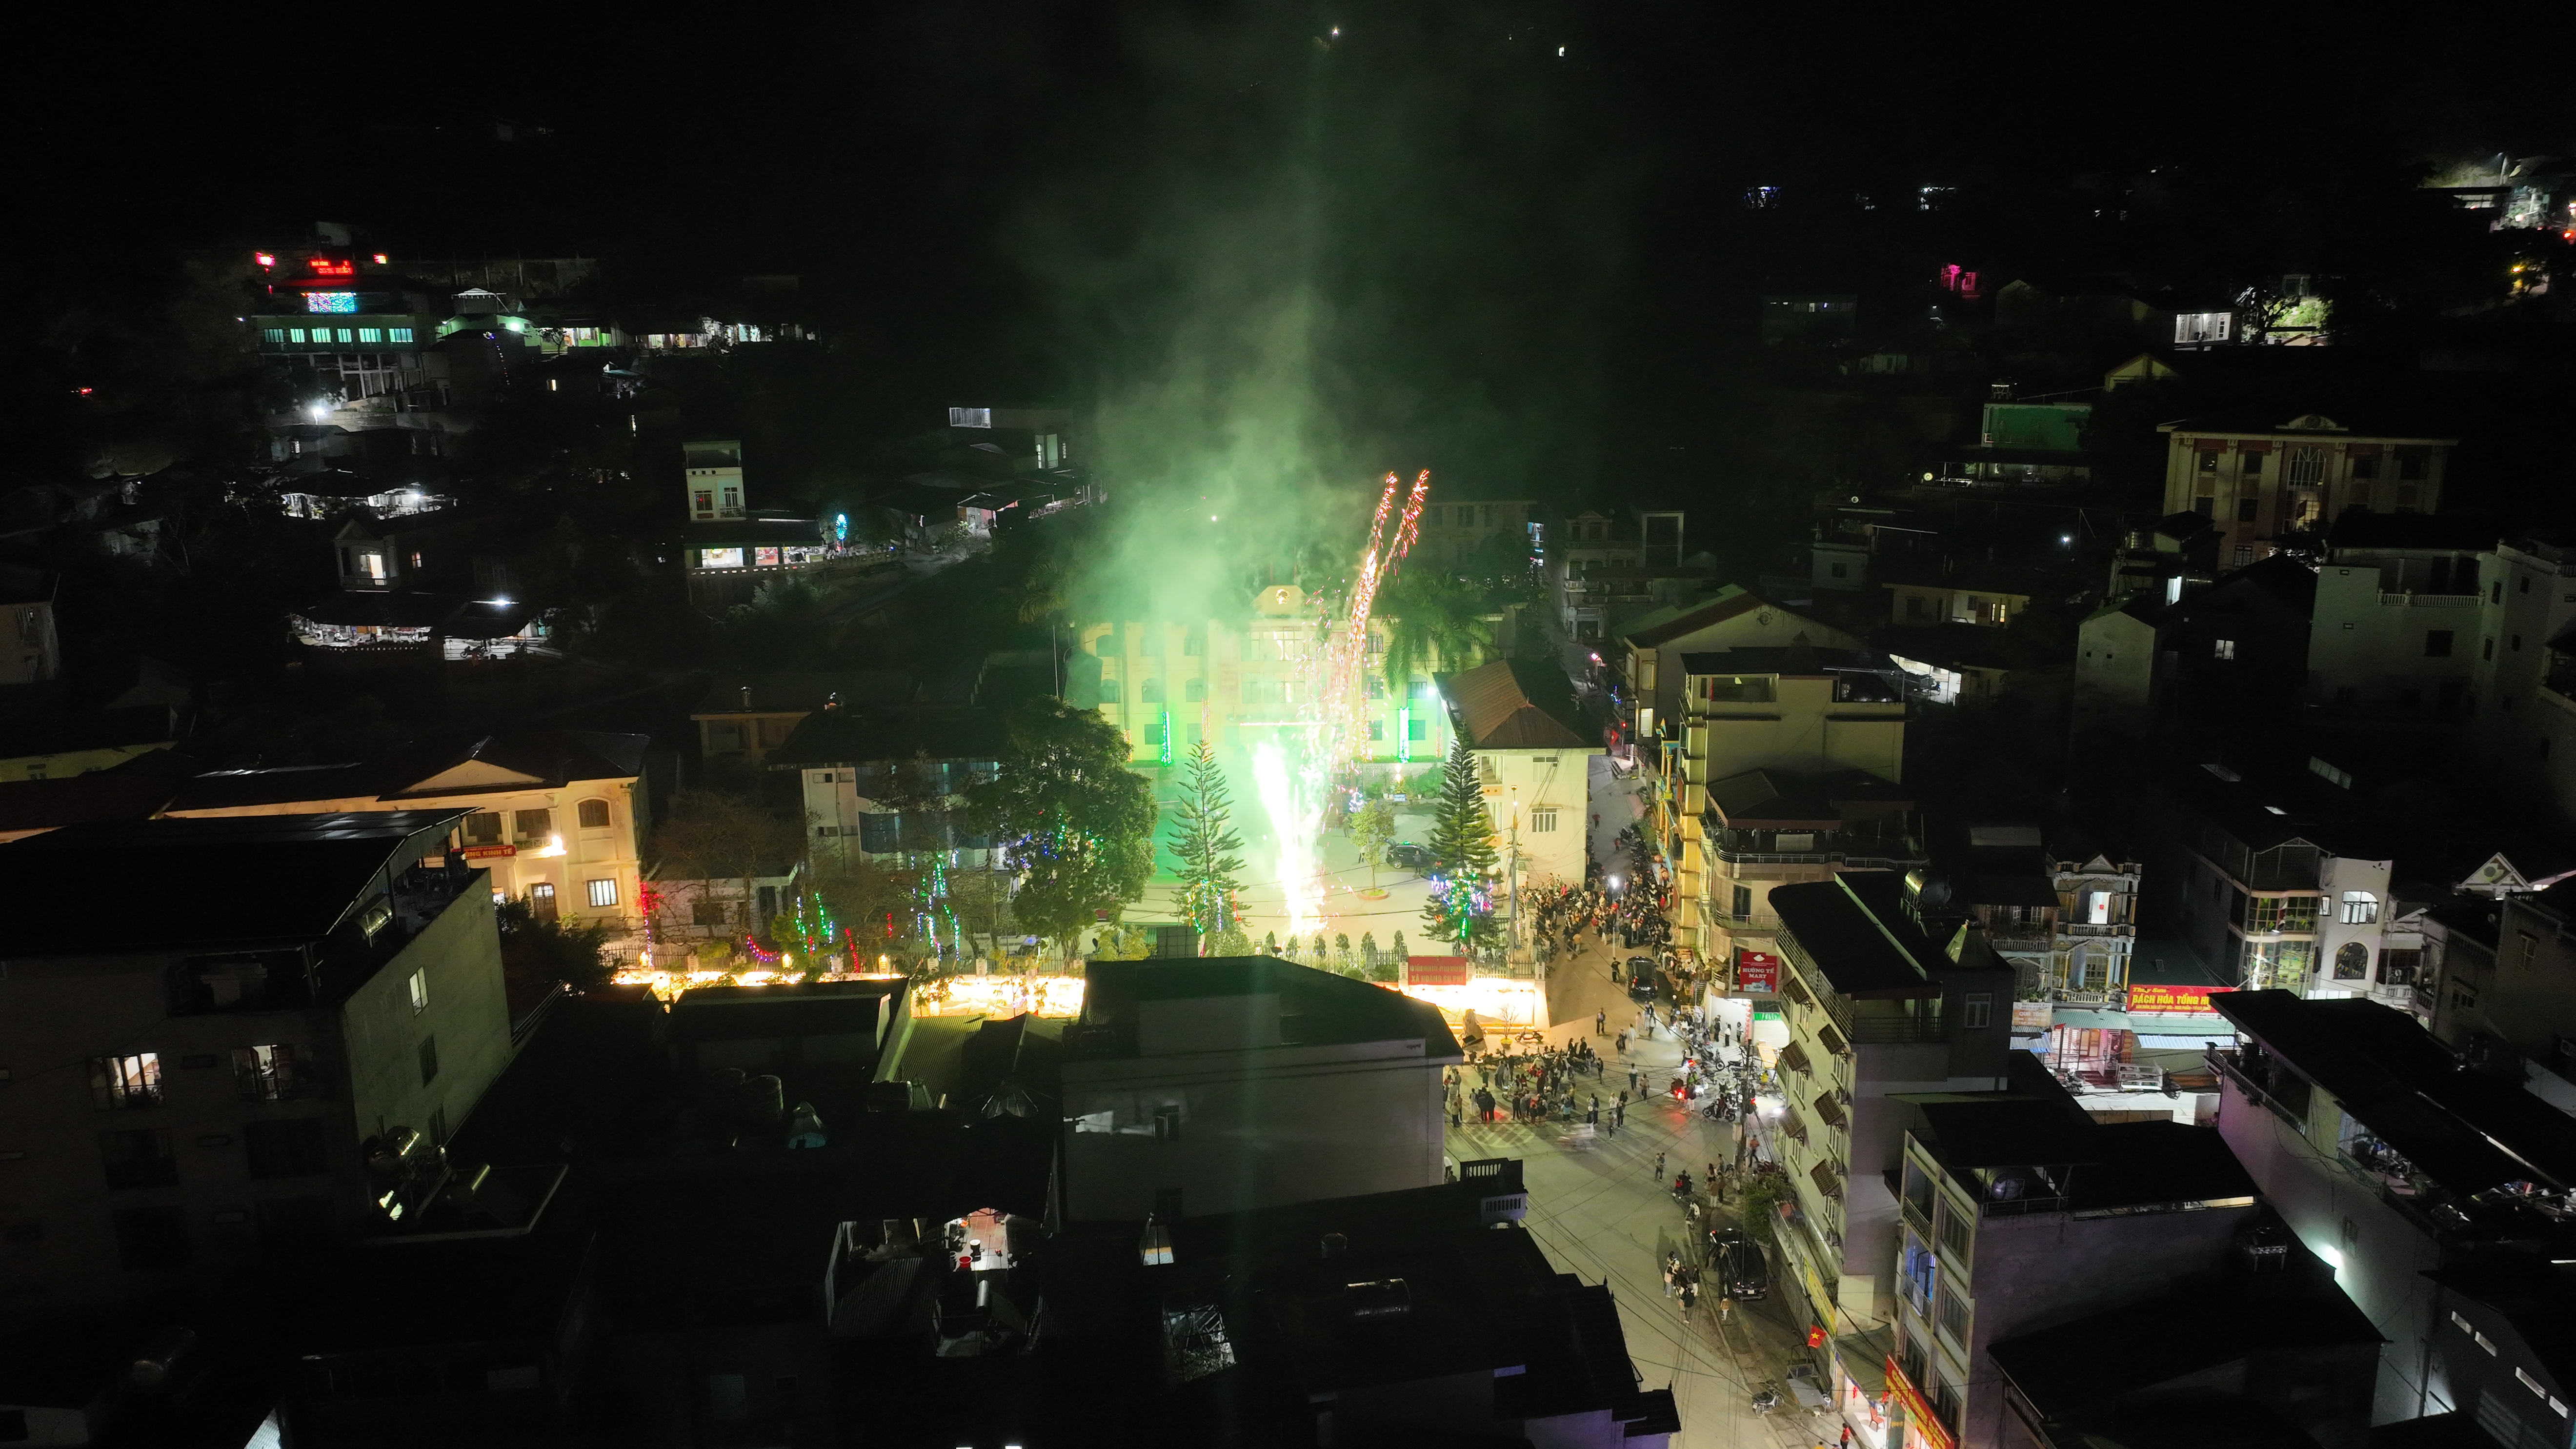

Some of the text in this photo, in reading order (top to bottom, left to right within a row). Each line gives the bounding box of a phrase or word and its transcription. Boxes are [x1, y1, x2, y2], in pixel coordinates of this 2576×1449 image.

[2132, 993, 2155, 1004] BÁCH
[2156, 994, 2174, 1004] HÓA
[2176, 993, 2199, 1005] TỔNG
